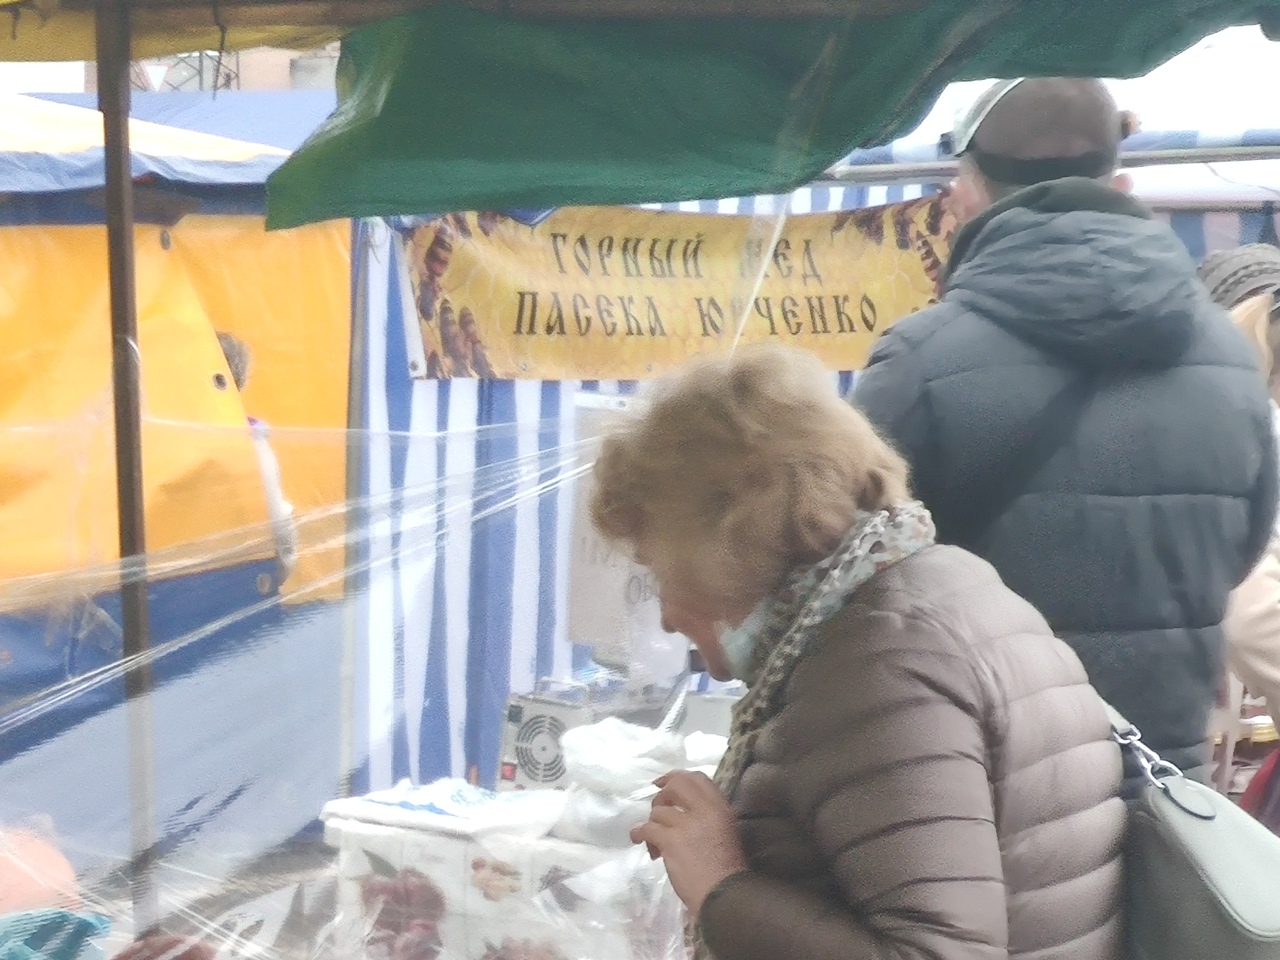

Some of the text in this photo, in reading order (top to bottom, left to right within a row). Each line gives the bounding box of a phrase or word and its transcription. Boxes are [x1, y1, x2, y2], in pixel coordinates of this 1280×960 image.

[551, 232, 705, 278] ГОРНЫЙ
[513, 290, 878, 337] ПАСЕКА ЮЧЕНКО
